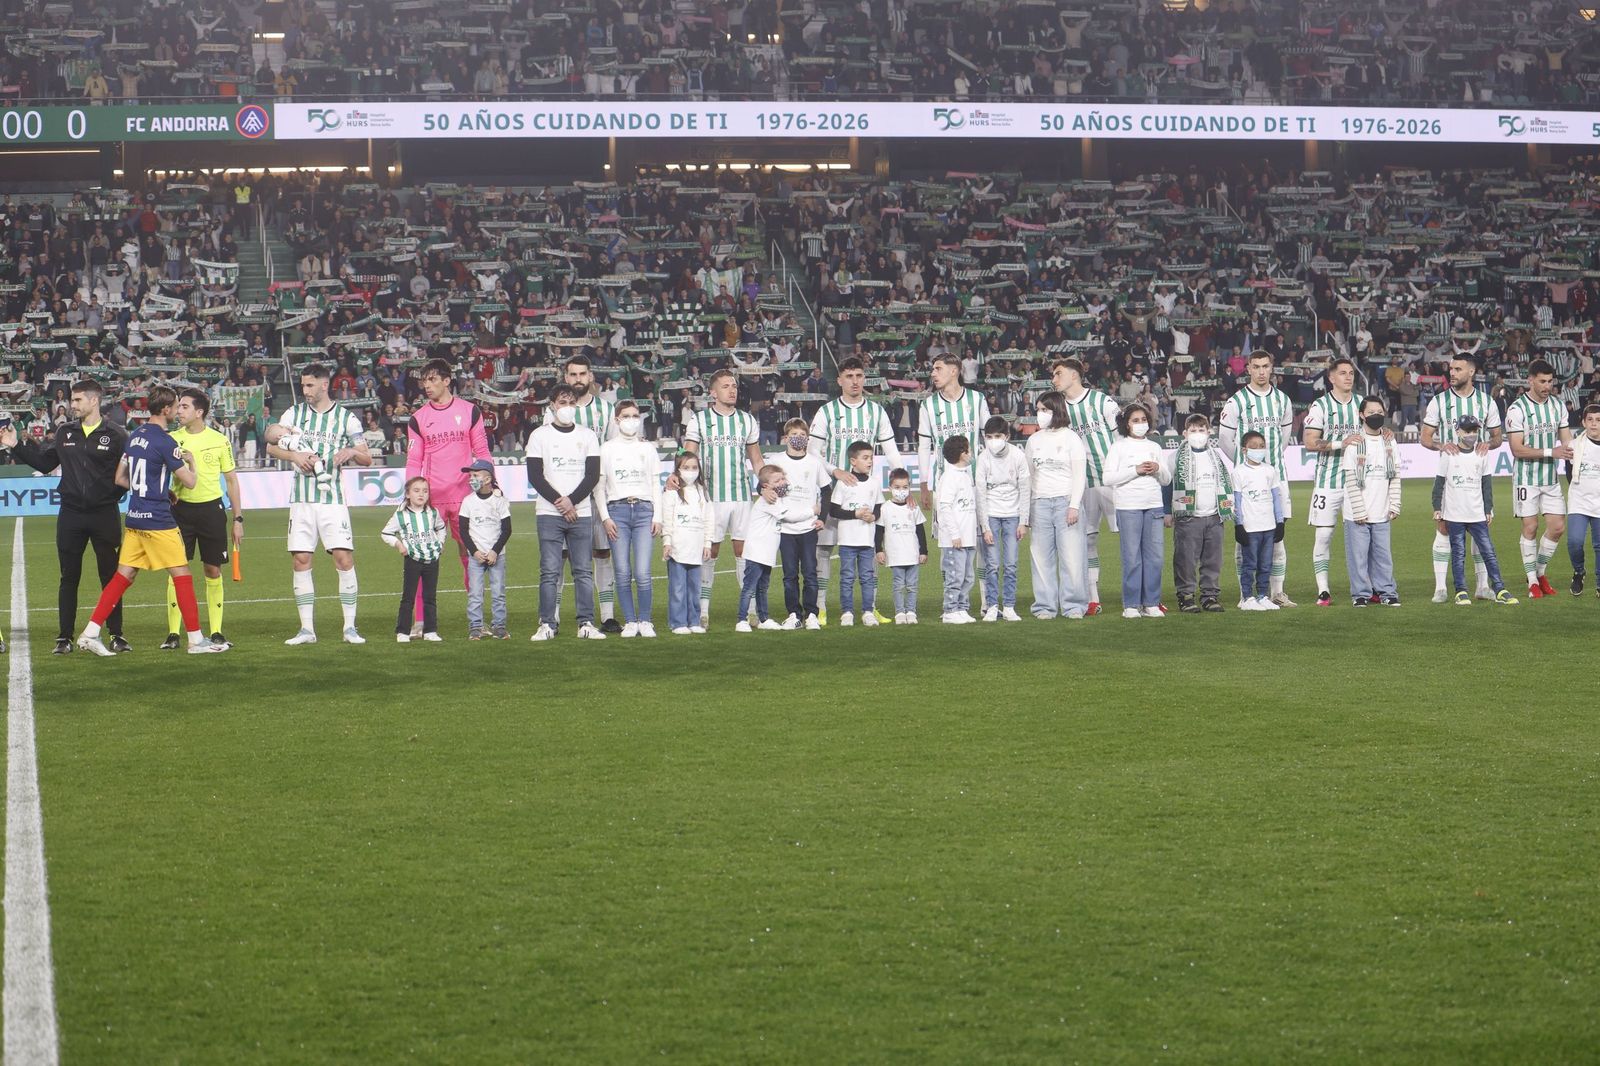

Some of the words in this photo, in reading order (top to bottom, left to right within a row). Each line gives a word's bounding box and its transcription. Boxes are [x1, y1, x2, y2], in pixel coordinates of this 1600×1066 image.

[68, 109, 87, 139] 0
[126, 117, 146, 133] FC
[151, 116, 230, 132] ANDORRA
[308, 109, 341, 132] 50
[424, 114, 449, 131] 50
[458, 109, 524, 130] AÑOS
[533, 113, 661, 130] CUIDANDO
[670, 113, 697, 130] DE
[706, 113, 728, 130] TI
[756, 113, 869, 130] 1976-2026
[934, 108, 966, 131] 50
[1041, 115, 1064, 131] 50
[1072, 110, 1133, 131] AÑOS
[1140, 115, 1256, 132] CUIDANDO
[1264, 116, 1289, 133] DE
[1296, 117, 1316, 133] TI
[1341, 118, 1442, 135] 1976-2026
[1498, 115, 1526, 137] 50
[303, 430, 337, 440] AHRAIN
[426, 430, 464, 441] BAHRAIN
[938, 422, 974, 432] BAHRAIN
[128, 456, 148, 498] 14
[358, 470, 404, 506] 50
[1313, 494, 1326, 510] 23
[1517, 488, 1527, 501] 10
[128, 510, 152, 518] Andorra
